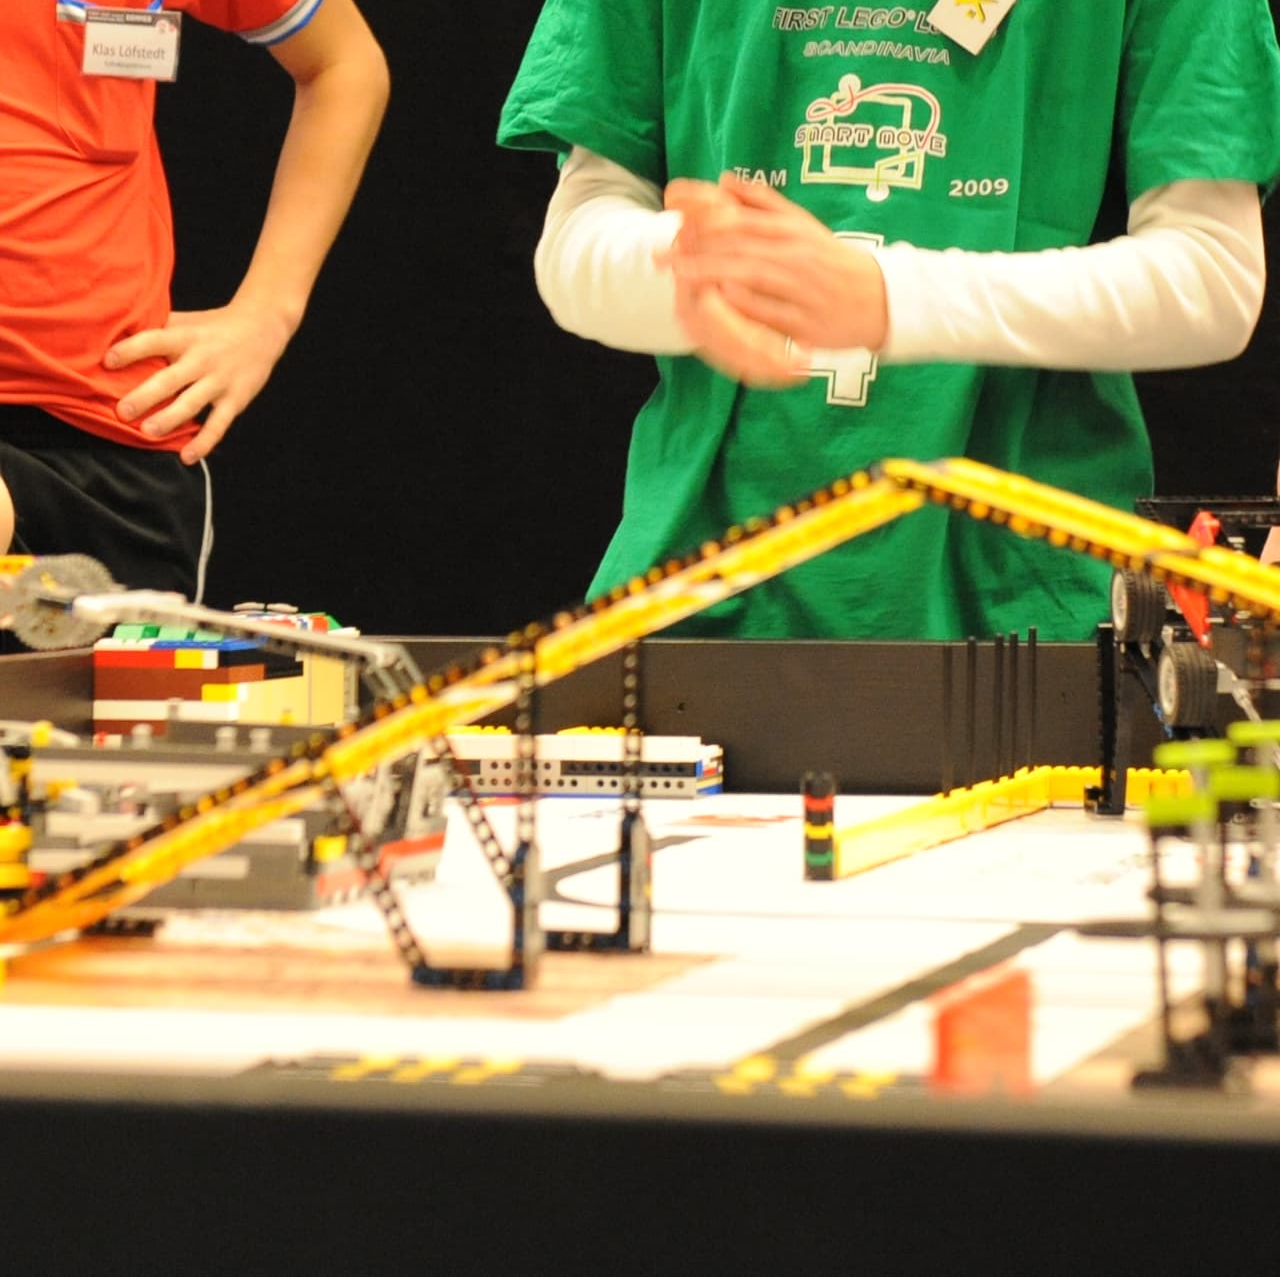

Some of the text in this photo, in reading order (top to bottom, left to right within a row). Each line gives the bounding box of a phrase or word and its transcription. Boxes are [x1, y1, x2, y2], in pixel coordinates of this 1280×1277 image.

[773, 6, 835, 30] FIRST
[92, 43, 116, 57] Klas
[803, 39, 950, 65] SCANDINAVIA
[795, 124, 946, 156] SMART MOVE
[733, 166, 1009, 197] TEAM 2009
